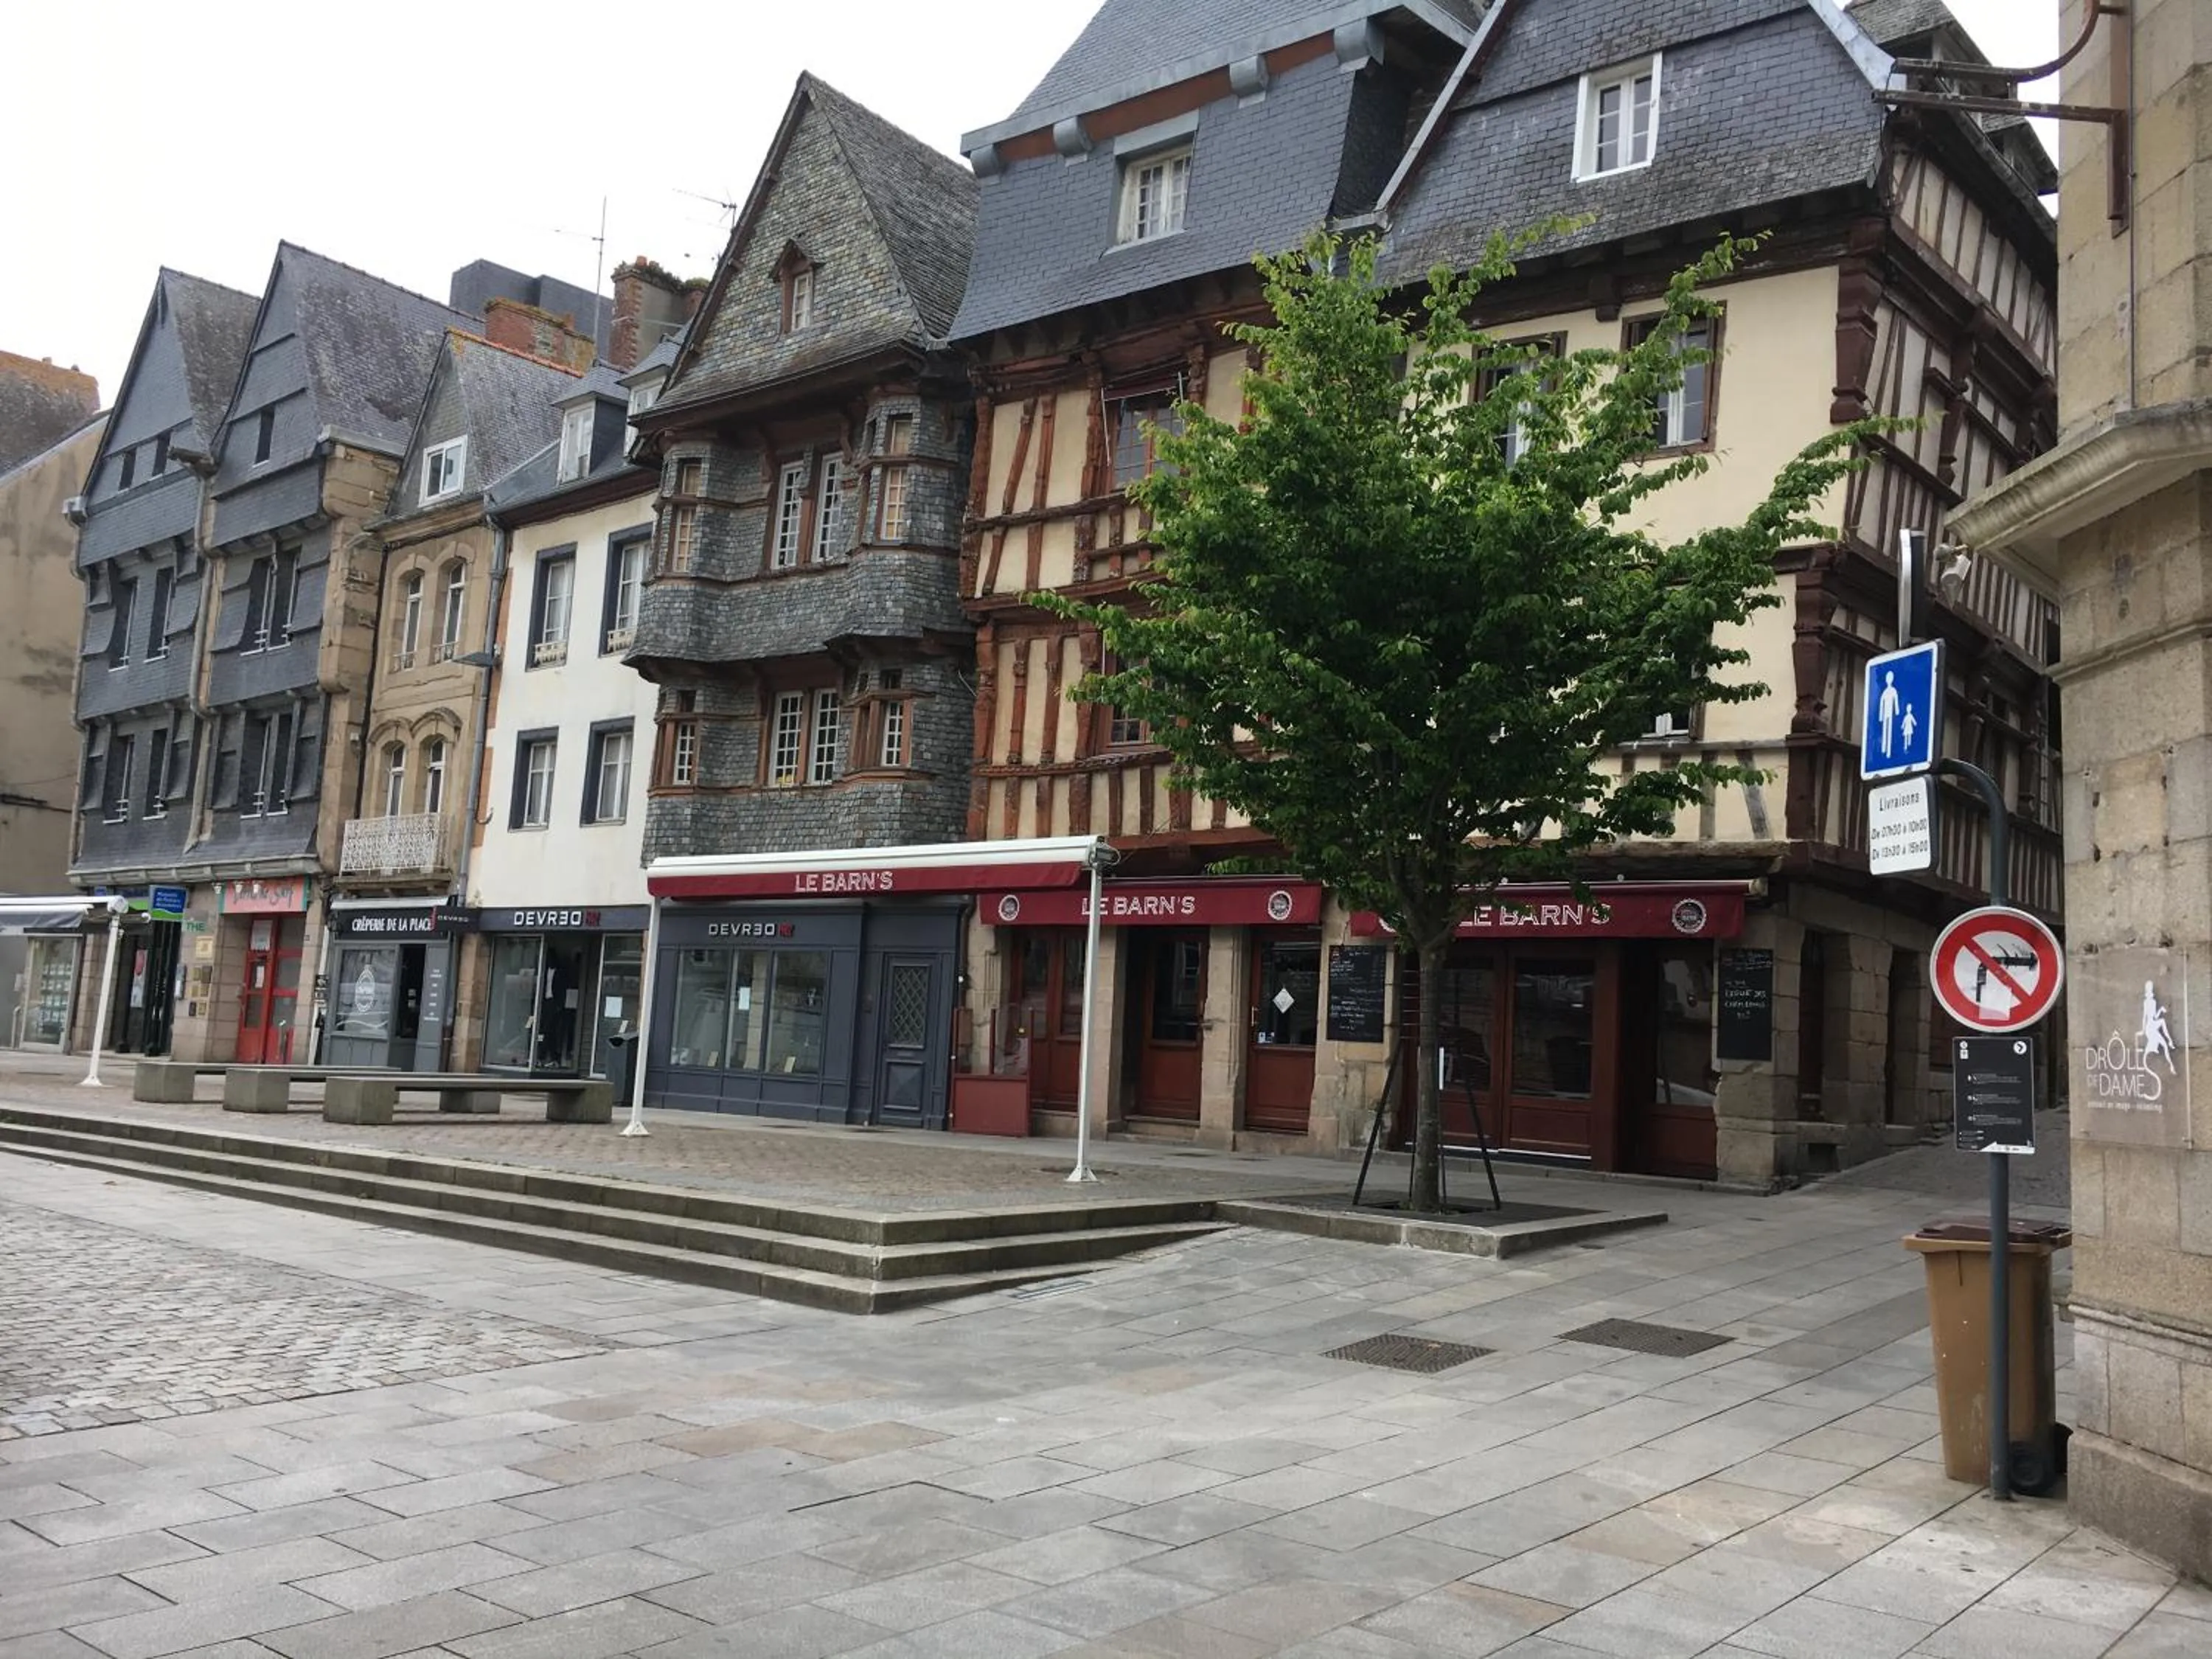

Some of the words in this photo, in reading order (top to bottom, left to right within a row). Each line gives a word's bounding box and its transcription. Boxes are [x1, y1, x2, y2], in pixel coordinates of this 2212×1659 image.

[1879, 793, 1919, 812] Livraisons
[794, 873, 818, 893] LE
[821, 871, 894, 892] BARN'S
[1112, 895, 1196, 916] BARN'S
[386, 917, 397, 931] DE
[398, 917, 408, 931] LA
